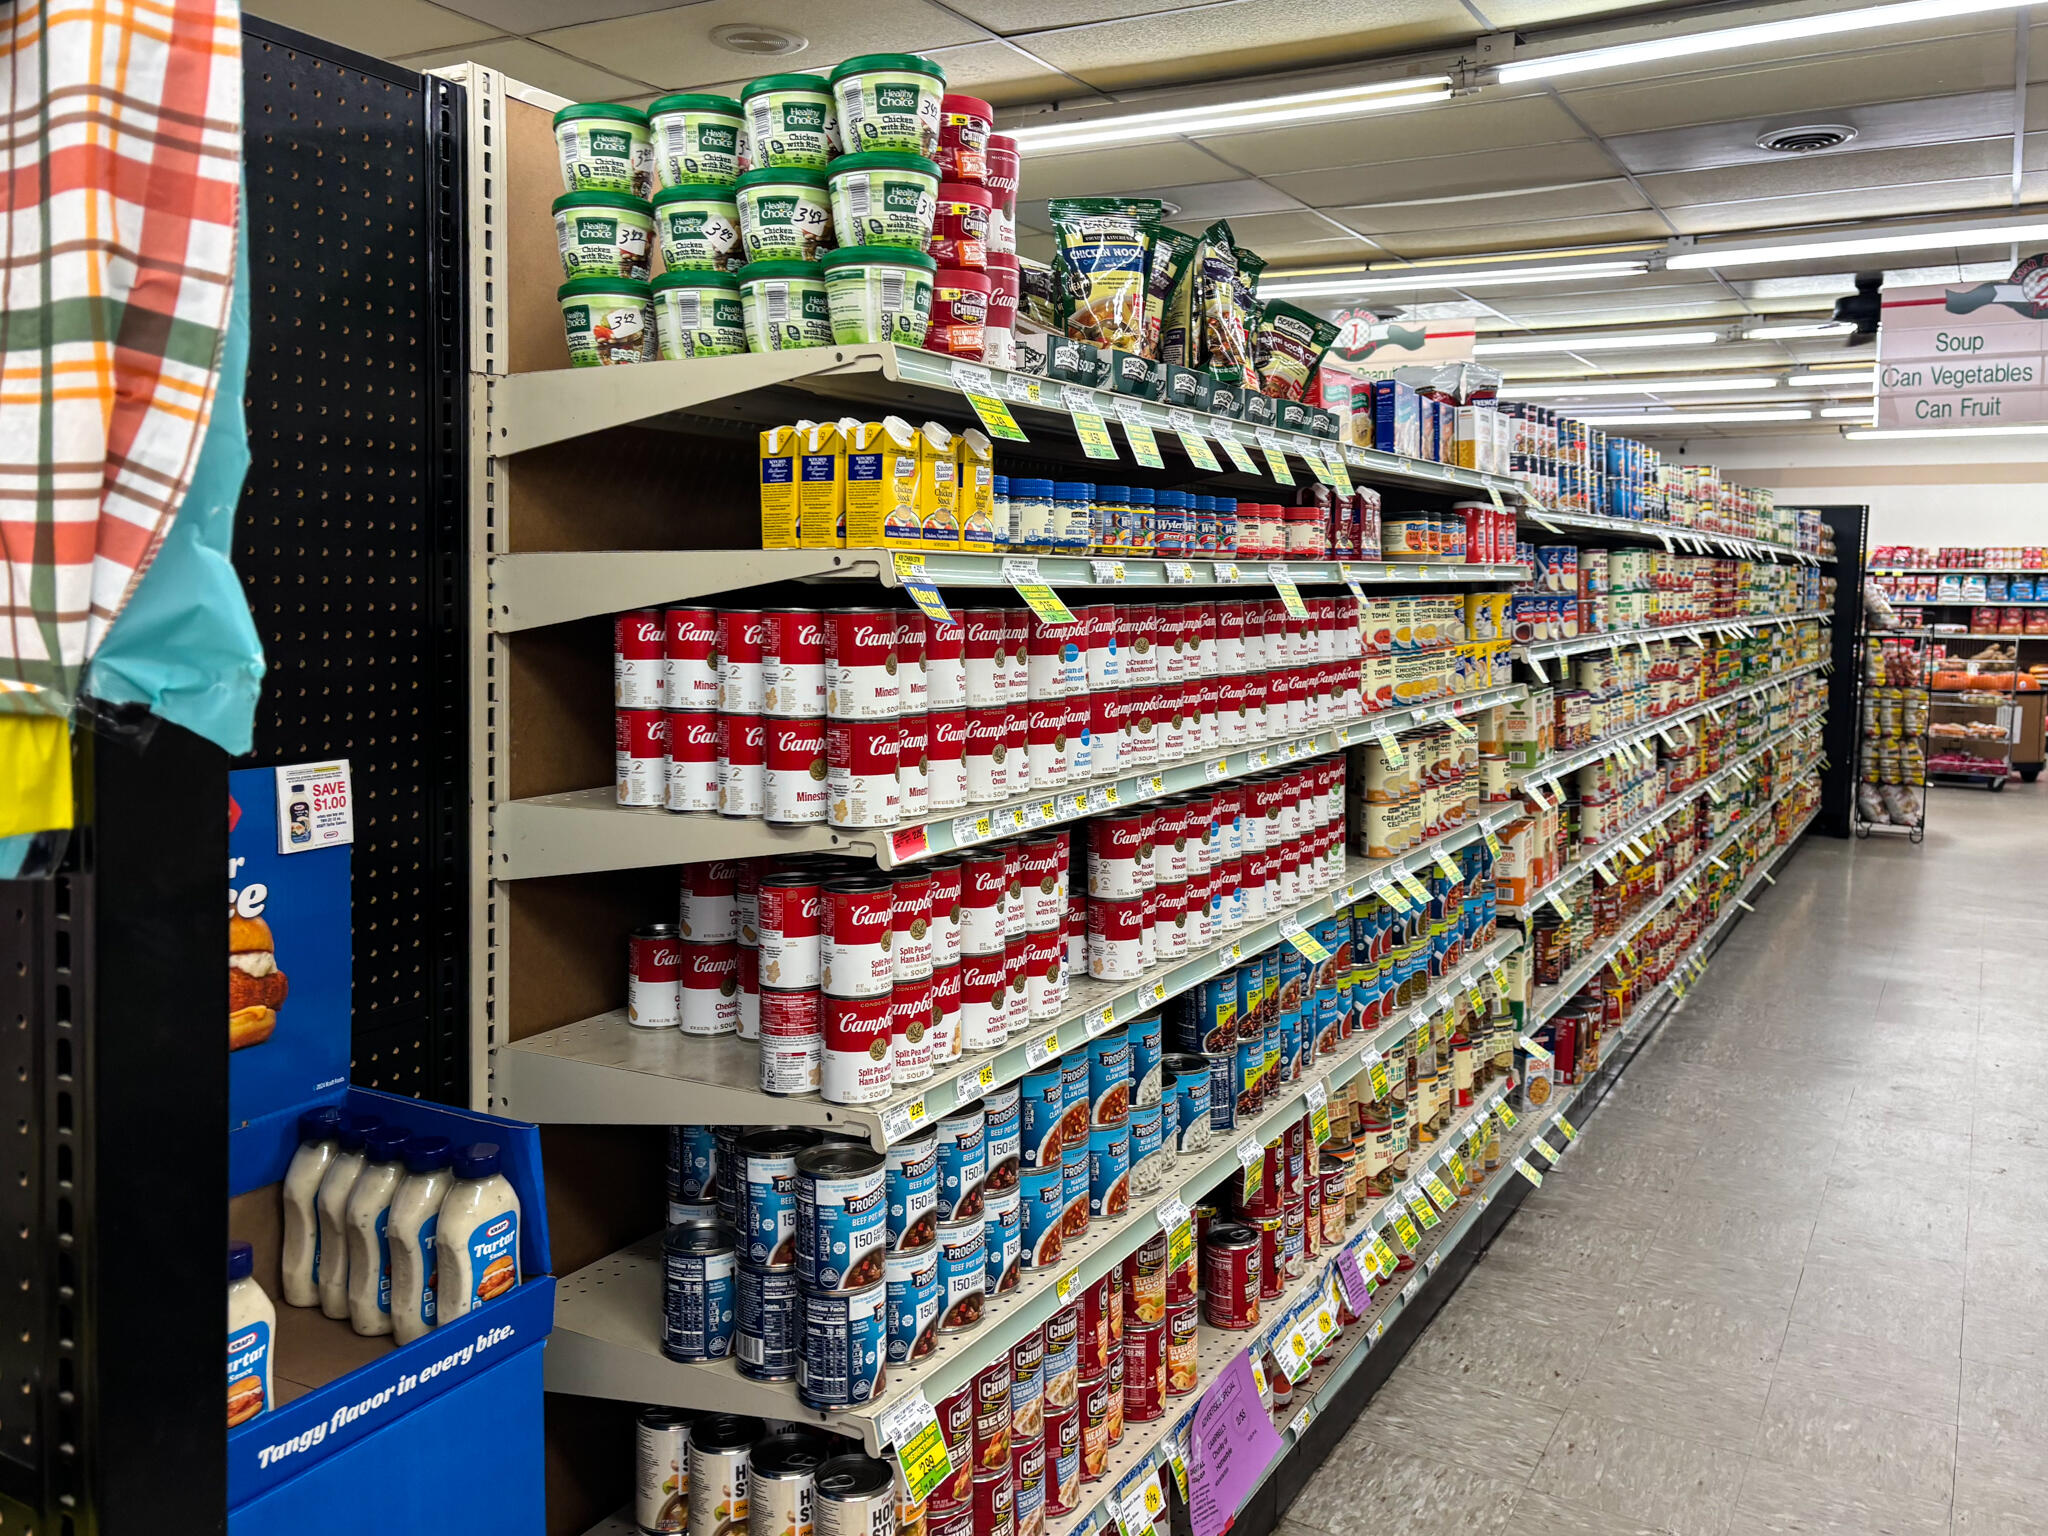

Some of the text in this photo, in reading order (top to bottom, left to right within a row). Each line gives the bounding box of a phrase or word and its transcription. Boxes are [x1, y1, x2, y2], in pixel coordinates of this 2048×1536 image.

[883, 89, 913, 100] Healthy
[879, 97, 915, 107] Choice
[791, 108, 820, 118] Healthy
[787, 115, 822, 125] Choice
[883, 116, 913, 124] Chicken
[900, 124, 915, 132] Rice
[597, 134, 626, 144] Healthy
[706, 129, 733, 140] Healthy
[789, 134, 819, 142] Chicken
[593, 142, 626, 151] Choice
[701, 137, 733, 147] Choice
[595, 158, 624, 167] Chicken
[704, 154, 731, 163] Chicken
[891, 186, 919, 197] Healthy
[887, 195, 919, 205] Choice
[764, 202, 793, 213] Healthy
[761, 209, 793, 219] Choice
[889, 214, 918, 223] Chicken
[583, 222, 611, 231] Healthy
[675, 218, 702, 226] Healthy
[580, 229, 612, 238] Choice
[673, 225, 702, 234] Choice
[763, 227, 792, 235] Chicken
[781, 234, 795, 242] Rice
[1936, 332, 1984, 354] Soup
[1080, 360, 1095, 373] SOUP
[1882, 365, 2033, 388] Can Vegetables
[1916, 397, 2001, 418] Can Fruit
[895, 485, 912, 493] Chicken
[935, 489, 953, 497] Chicken
[897, 494, 910, 502] Stock
[938, 497, 950, 505] Stock
[909, 587, 941, 604] New
[313, 781, 345, 796] SAVE
[314, 796, 346, 812] $1.00
[1036, 907, 1048, 916] with
[1041, 919, 1056, 927] SOUP
[900, 946, 923, 956] Split Pea
[900, 955, 912, 964] Ham
[910, 968, 928, 977] SOUP
[895, 1050, 908, 1058] Split
[909, 1048, 919, 1057] Pea
[896, 1058, 908, 1067] Ham
[858, 1069, 871, 1078] Split
[873, 1068, 883, 1076] Pea
[906, 1071, 927, 1080] SOUP
[859, 1076, 872, 1086] Ham
[869, 1090, 887, 1099] SOUP
[992, 1143, 1008, 1156] 150
[963, 1153, 975, 1161] BEEF
[964, 1168, 978, 1181] 150
[865, 1174, 883, 1188] LIGHT
[909, 1180, 921, 1190] BEEF
[910, 1196, 927, 1210] 150
[851, 1213, 879, 1227] BEEF POT
[489, 1221, 507, 1235] KRAFT
[962, 1227, 980, 1238] LIGHT
[474, 1229, 515, 1258] Tartar
[854, 1232, 873, 1249] 150
[489, 1249, 507, 1261] Sauce
[951, 1261, 974, 1272] BEEF POT
[952, 1278, 969, 1292] 150
[228, 1367, 253, 1382] Sauce
[1221, 1381, 1236, 1401] SPECIAL
[258, 1323, 516, 1470] Tangy flavor in every bite.
[978, 1406, 1009, 1429] BEEF
